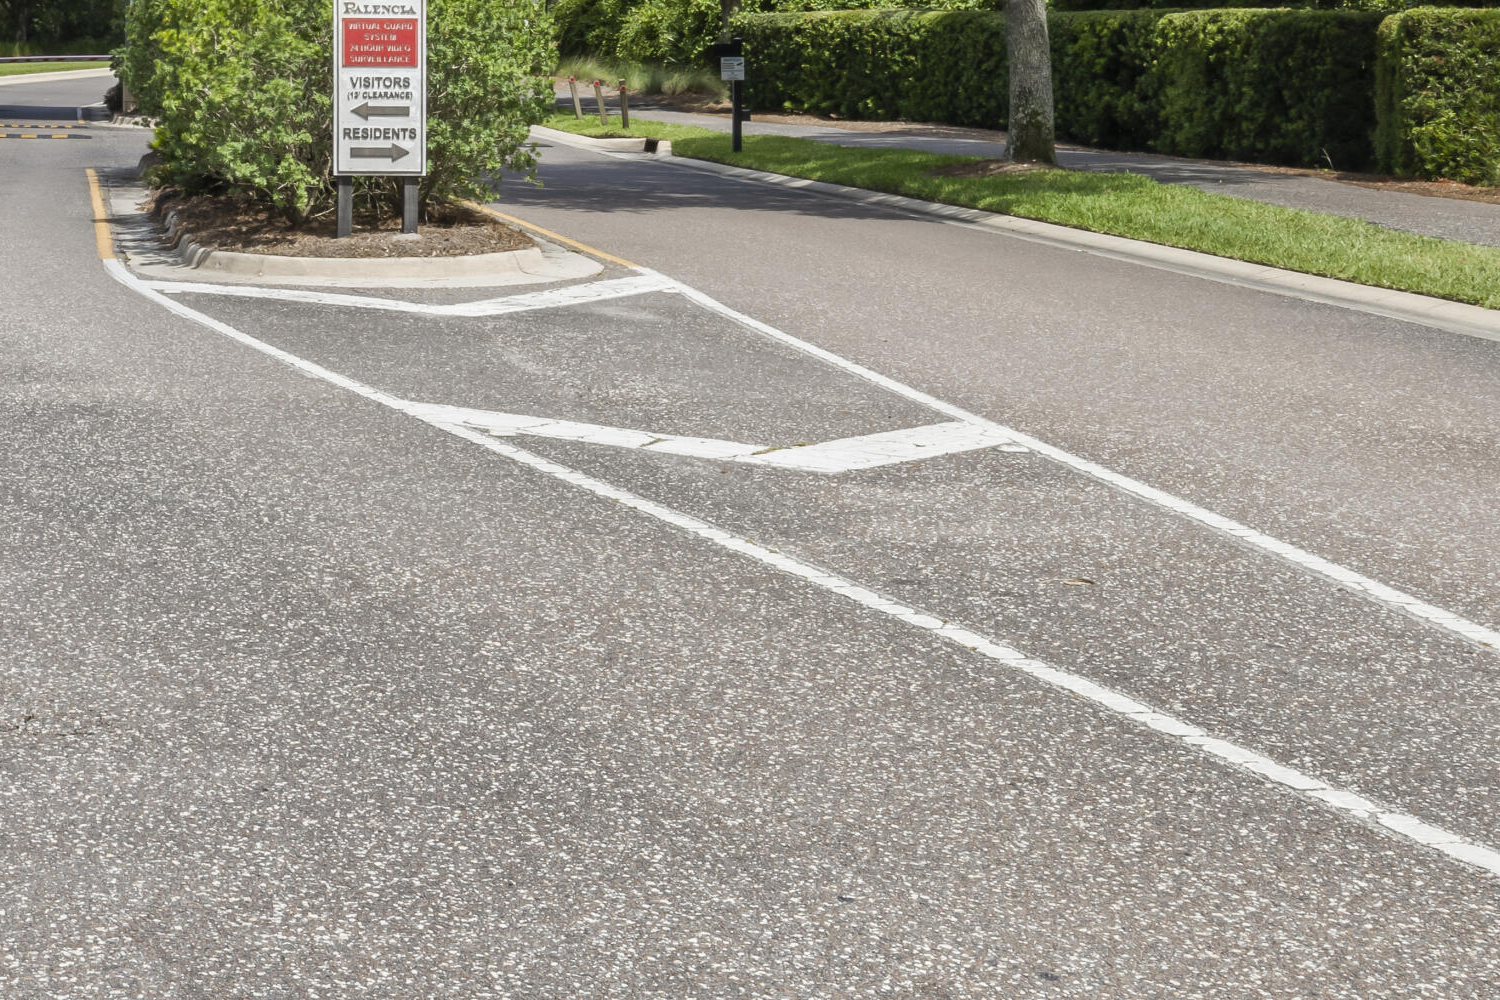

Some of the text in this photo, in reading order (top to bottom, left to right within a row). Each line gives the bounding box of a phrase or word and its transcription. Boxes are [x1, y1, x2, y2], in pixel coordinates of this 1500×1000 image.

[343, 1, 417, 15] PALENCIA
[348, 22, 413, 30] VIRTUAL GUARD
[363, 32, 397, 41] SYSTEM
[349, 44, 411, 52] 24 HOUR VIDEO
[349, 55, 409, 63] SURVEILLANCE
[349, 76, 411, 89] VISITORS
[362, 91, 413, 101] CLEARANCE)
[343, 127, 417, 140] RESIDENTS
